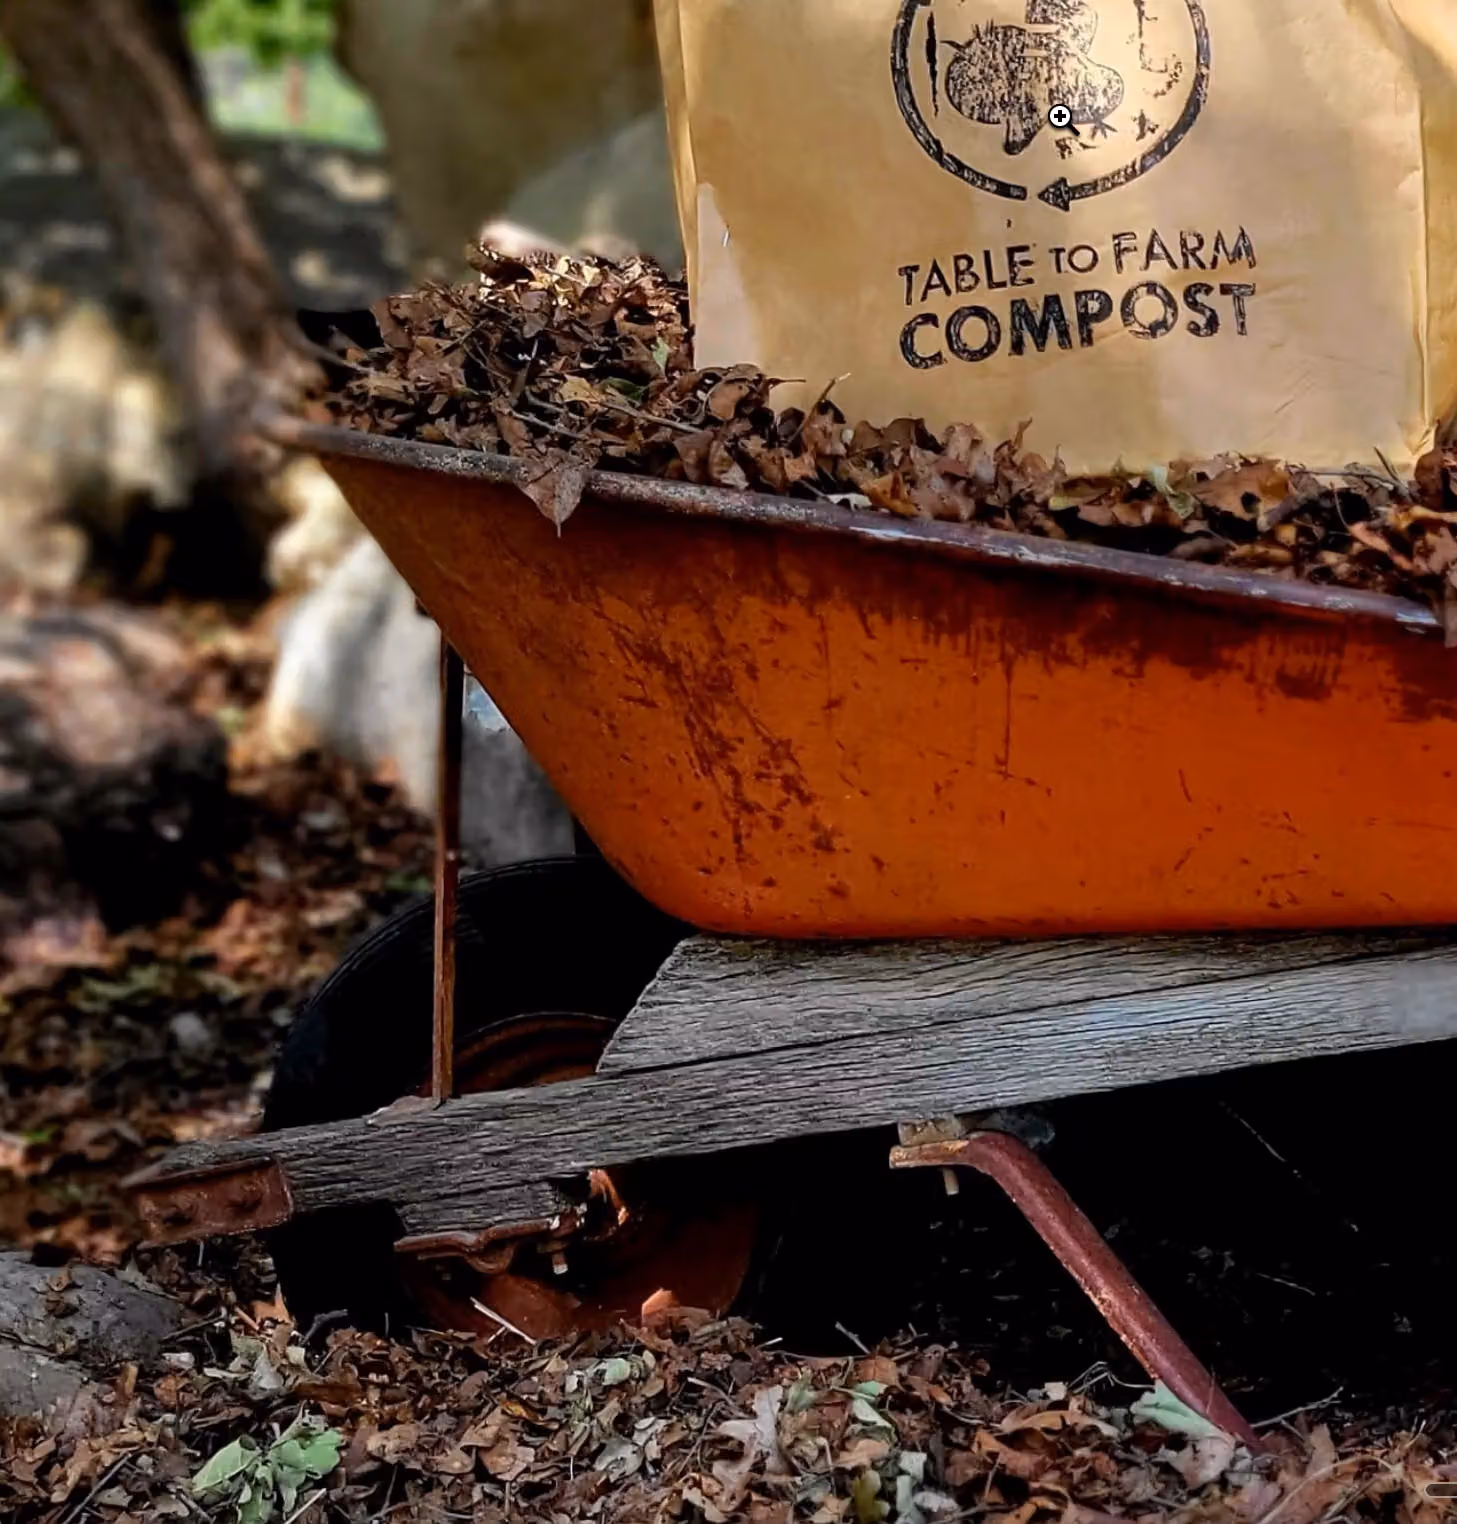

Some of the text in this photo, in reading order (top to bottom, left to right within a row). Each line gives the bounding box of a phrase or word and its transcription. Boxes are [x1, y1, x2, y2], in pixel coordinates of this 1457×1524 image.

[898, 225, 1257, 305] TABLE TO FARM
[900, 280, 1256, 370] COMPOST
